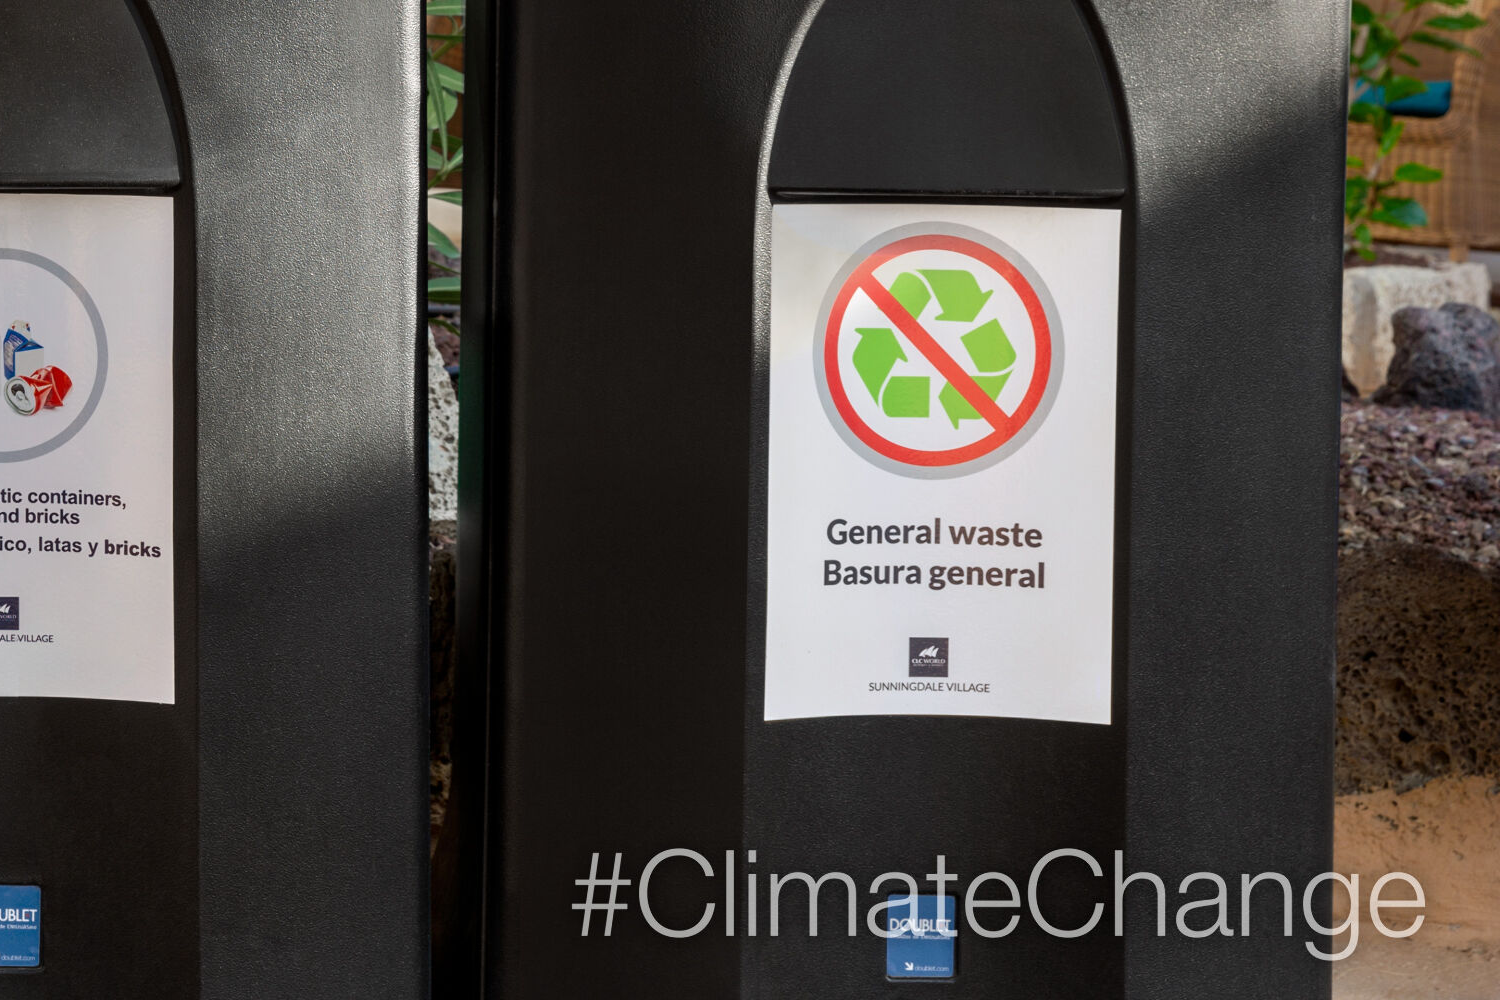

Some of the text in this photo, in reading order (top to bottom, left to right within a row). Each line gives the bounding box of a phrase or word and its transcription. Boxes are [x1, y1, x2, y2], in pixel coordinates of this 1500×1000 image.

[28, 488, 127, 511] containers,
[25, 508, 79, 524] bricks
[827, 518, 1042, 548] General waste
[39, 537, 82, 552] latas
[88, 542, 98, 557] y
[105, 539, 161, 558] bricks
[824, 560, 1044, 590] Basura general
[17, 635, 53, 643] VILLAGE
[869, 682, 990, 693] SUNNINGDALE VILLAGE
